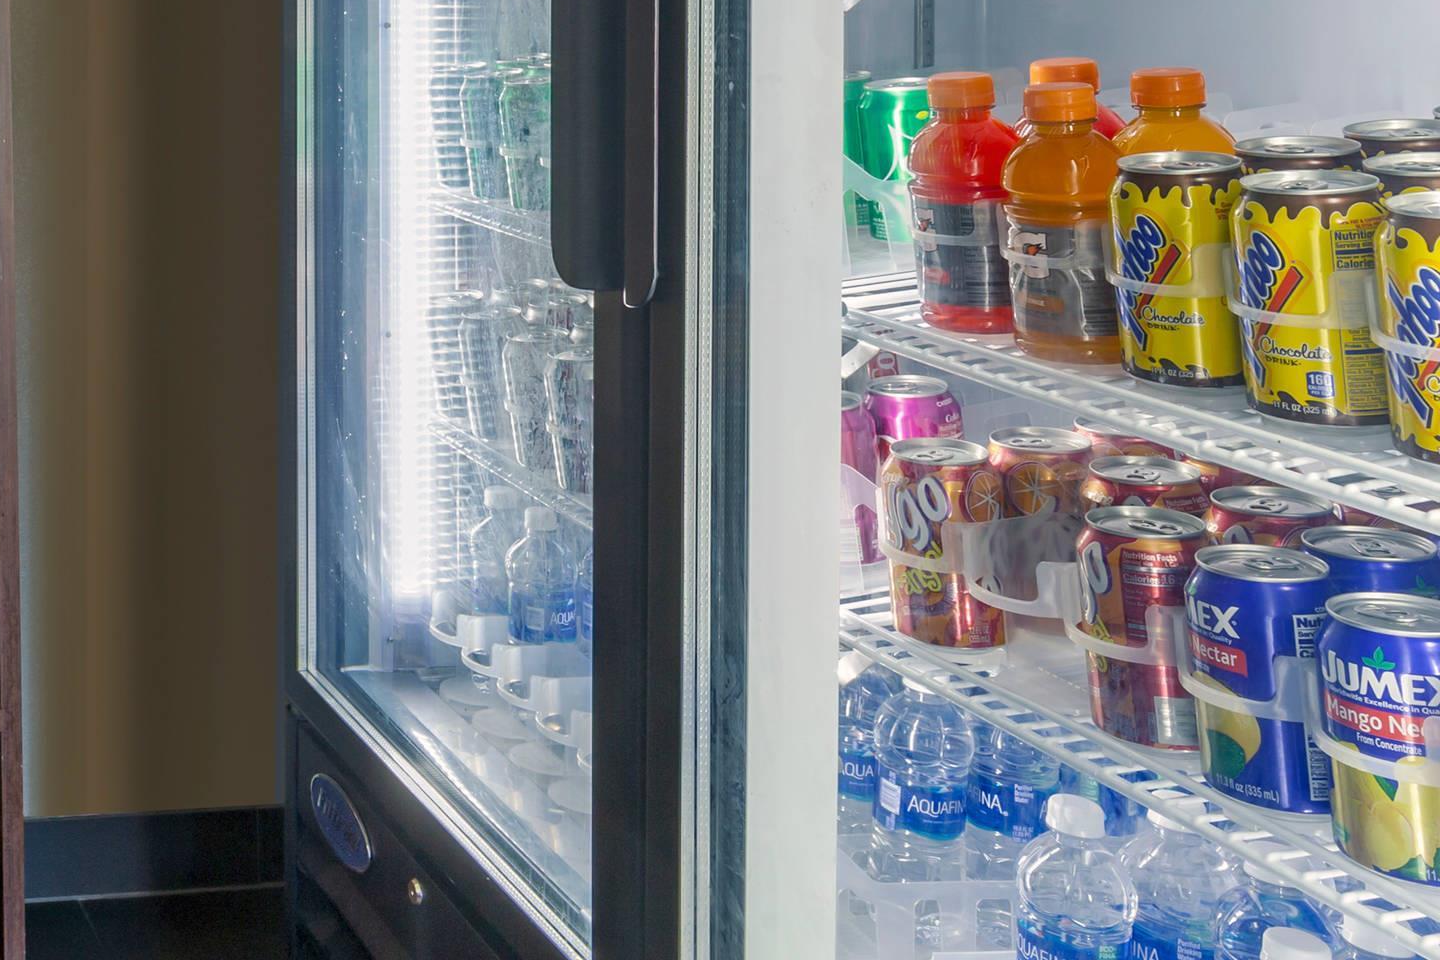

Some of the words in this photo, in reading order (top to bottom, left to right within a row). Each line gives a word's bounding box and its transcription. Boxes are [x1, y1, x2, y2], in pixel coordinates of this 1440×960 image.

[1334, 230, 1375, 240] Nutritio
[1336, 259, 1376, 269] Calorie
[1142, 306, 1205, 325] Chocolate
[1260, 336, 1334, 361] Chocolate
[1308, 372, 1331, 386] 160
[1281, 401, 1290, 410] FL
[1291, 403, 1302, 412] OZ
[1302, 404, 1321, 415] (325
[1122, 551, 1155, 562] Nutrition
[1156, 552, 1178, 562] Facts
[1186, 594, 1240, 640] MEX
[1191, 635, 1237, 667] Nectar
[1322, 650, 1440, 707] JUMEX
[1327, 693, 1383, 733] Mango
[1364, 696, 1409, 713] Excellence
[1410, 705, 1420, 713] in
[1356, 732, 1375, 746] From
[1375, 738, 1422, 756] Concentrate
[1216, 773, 1229, 785] 11.3
[1235, 784, 1244, 793] oz
[1244, 783, 1262, 798] (335
[1263, 789, 1280, 804] mL)
[907, 795, 964, 818] AQUAFIN
